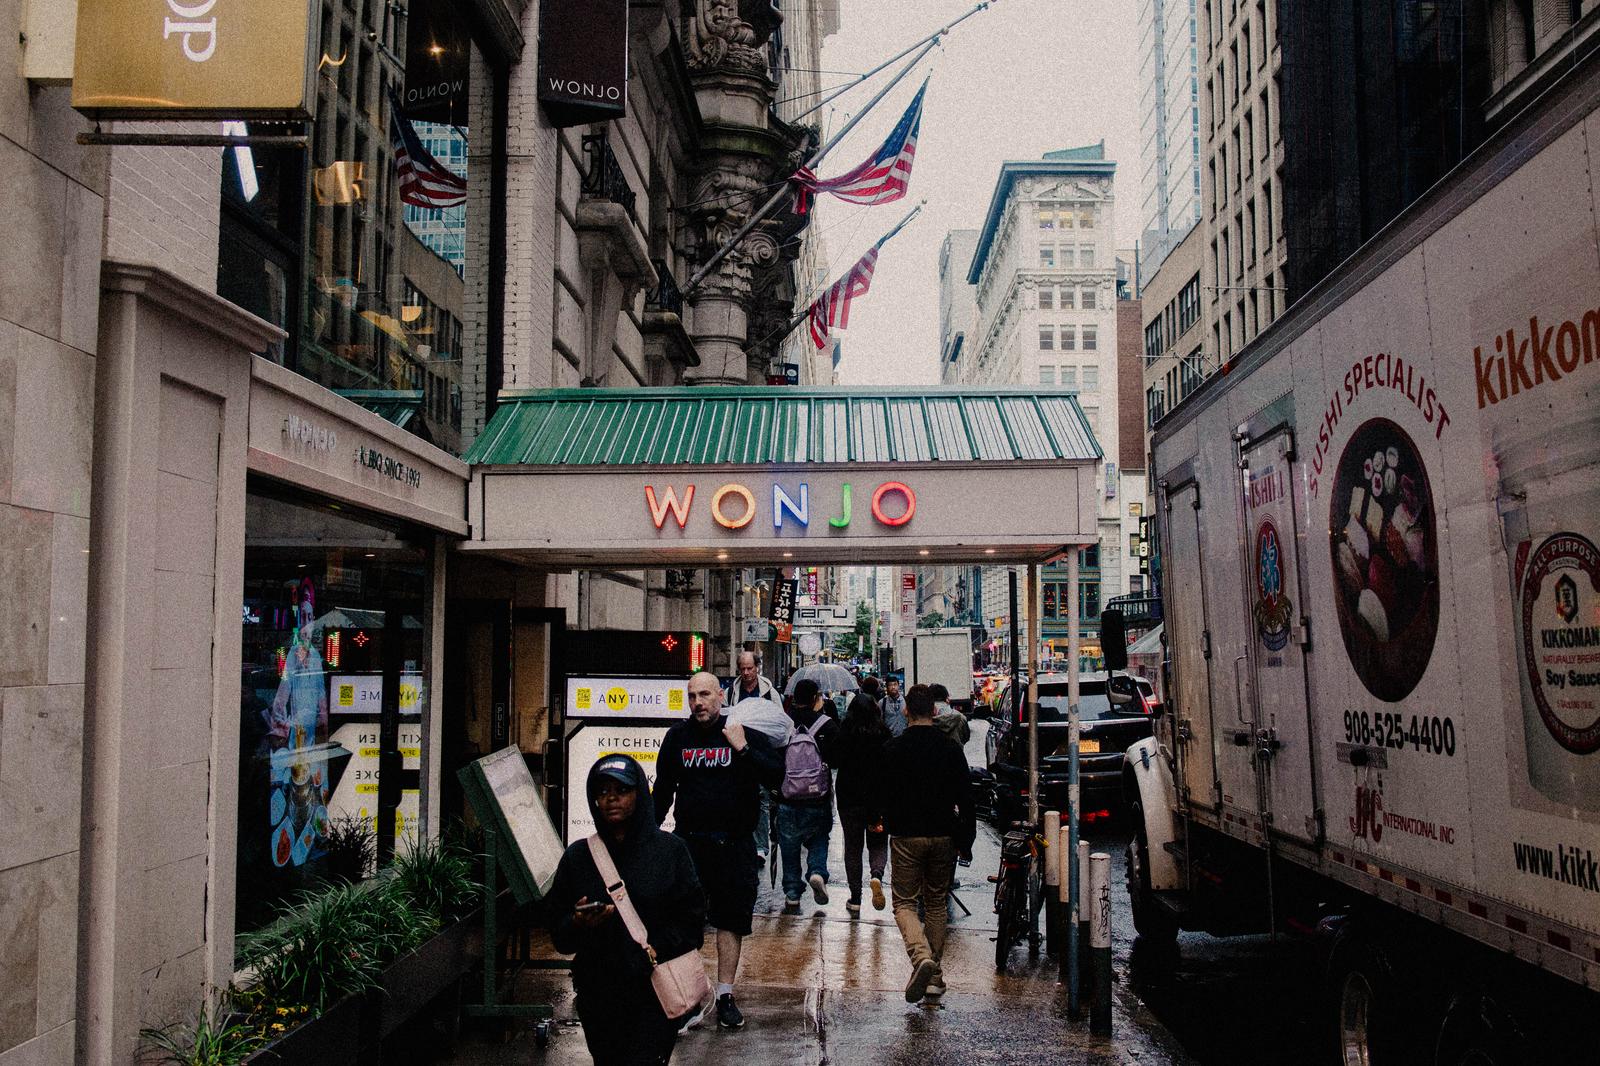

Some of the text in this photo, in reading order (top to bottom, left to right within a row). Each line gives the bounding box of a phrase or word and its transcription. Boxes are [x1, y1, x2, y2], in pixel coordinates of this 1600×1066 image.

[549, 77, 620, 100] WONJO
[1309, 353, 1451, 500] SUSHI SPECIALIST
[384, 456, 403, 482] SINCE
[405, 466, 420, 489] 1993
[644, 481, 917, 530] WONJO
[774, 606, 790, 619] 32
[1541, 626, 1600, 649] KIKKOMAN
[1546, 668, 1566, 690] Soy
[598, 693, 662, 704] ANYTIME
[598, 738, 661, 748] KITCHEN
[1343, 709, 1456, 757] 908-525-4400
[682, 747, 732, 768] WFMU
[1382, 811, 1455, 845] INTERNATIONAL INC
